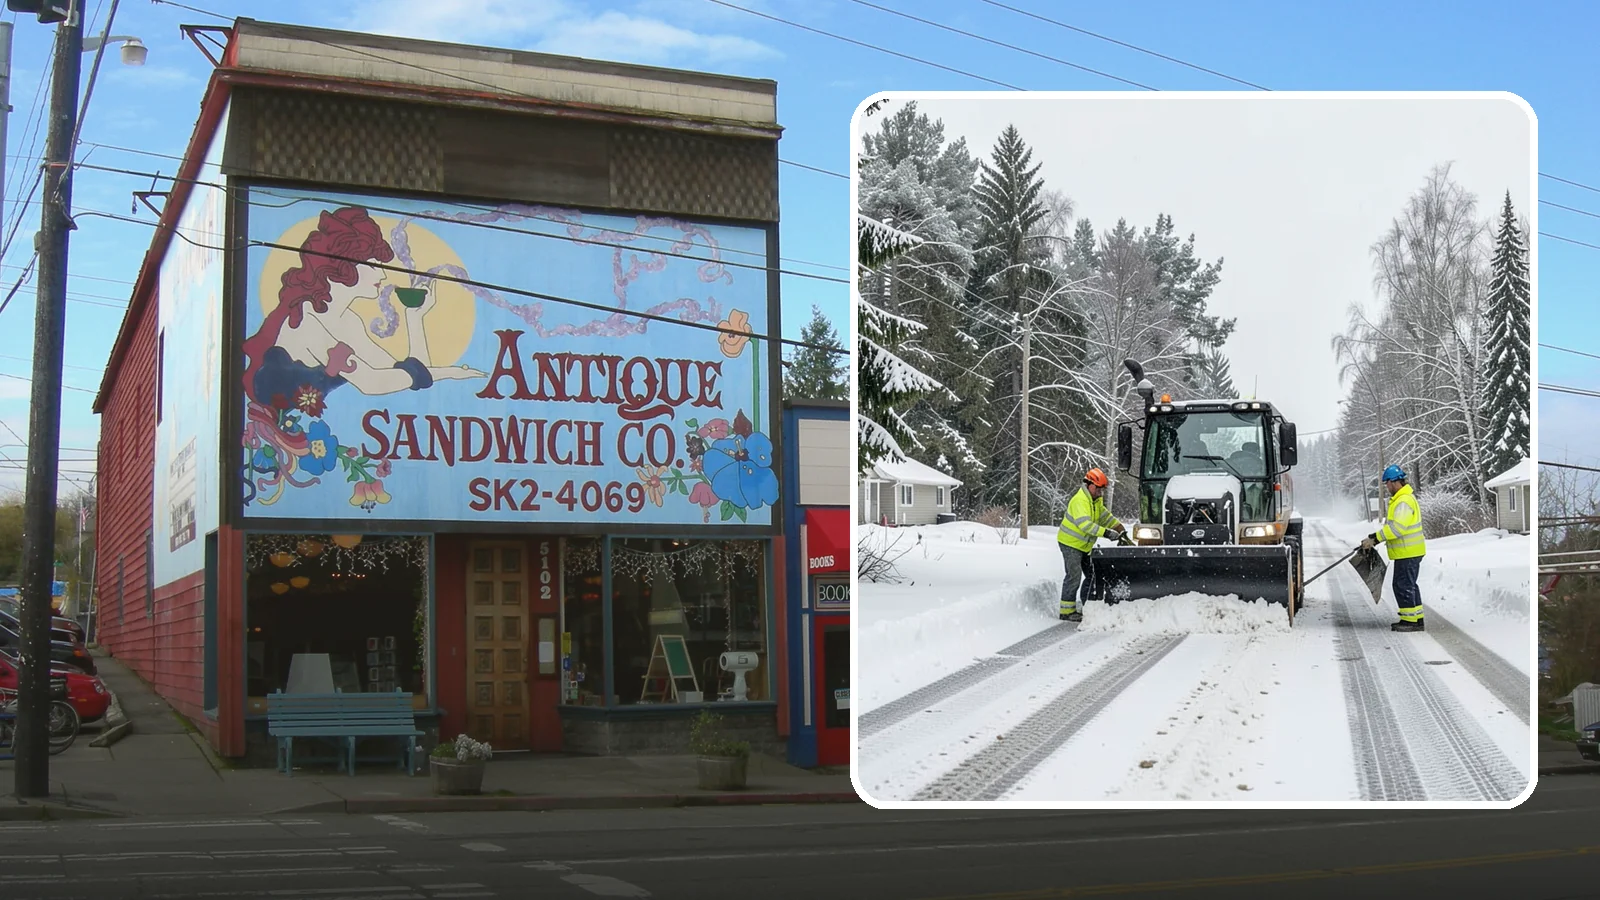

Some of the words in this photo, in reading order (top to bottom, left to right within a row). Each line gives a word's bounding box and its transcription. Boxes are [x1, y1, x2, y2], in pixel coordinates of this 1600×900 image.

[476, 329, 724, 421] ANTIQUE
[361, 408, 604, 467] SANDWICH
[617, 421, 685, 468] CO.
[468, 477, 646, 513] SK2-4069
[540, 542, 551, 599] 5102
[809, 555, 834, 568] BOOKS
